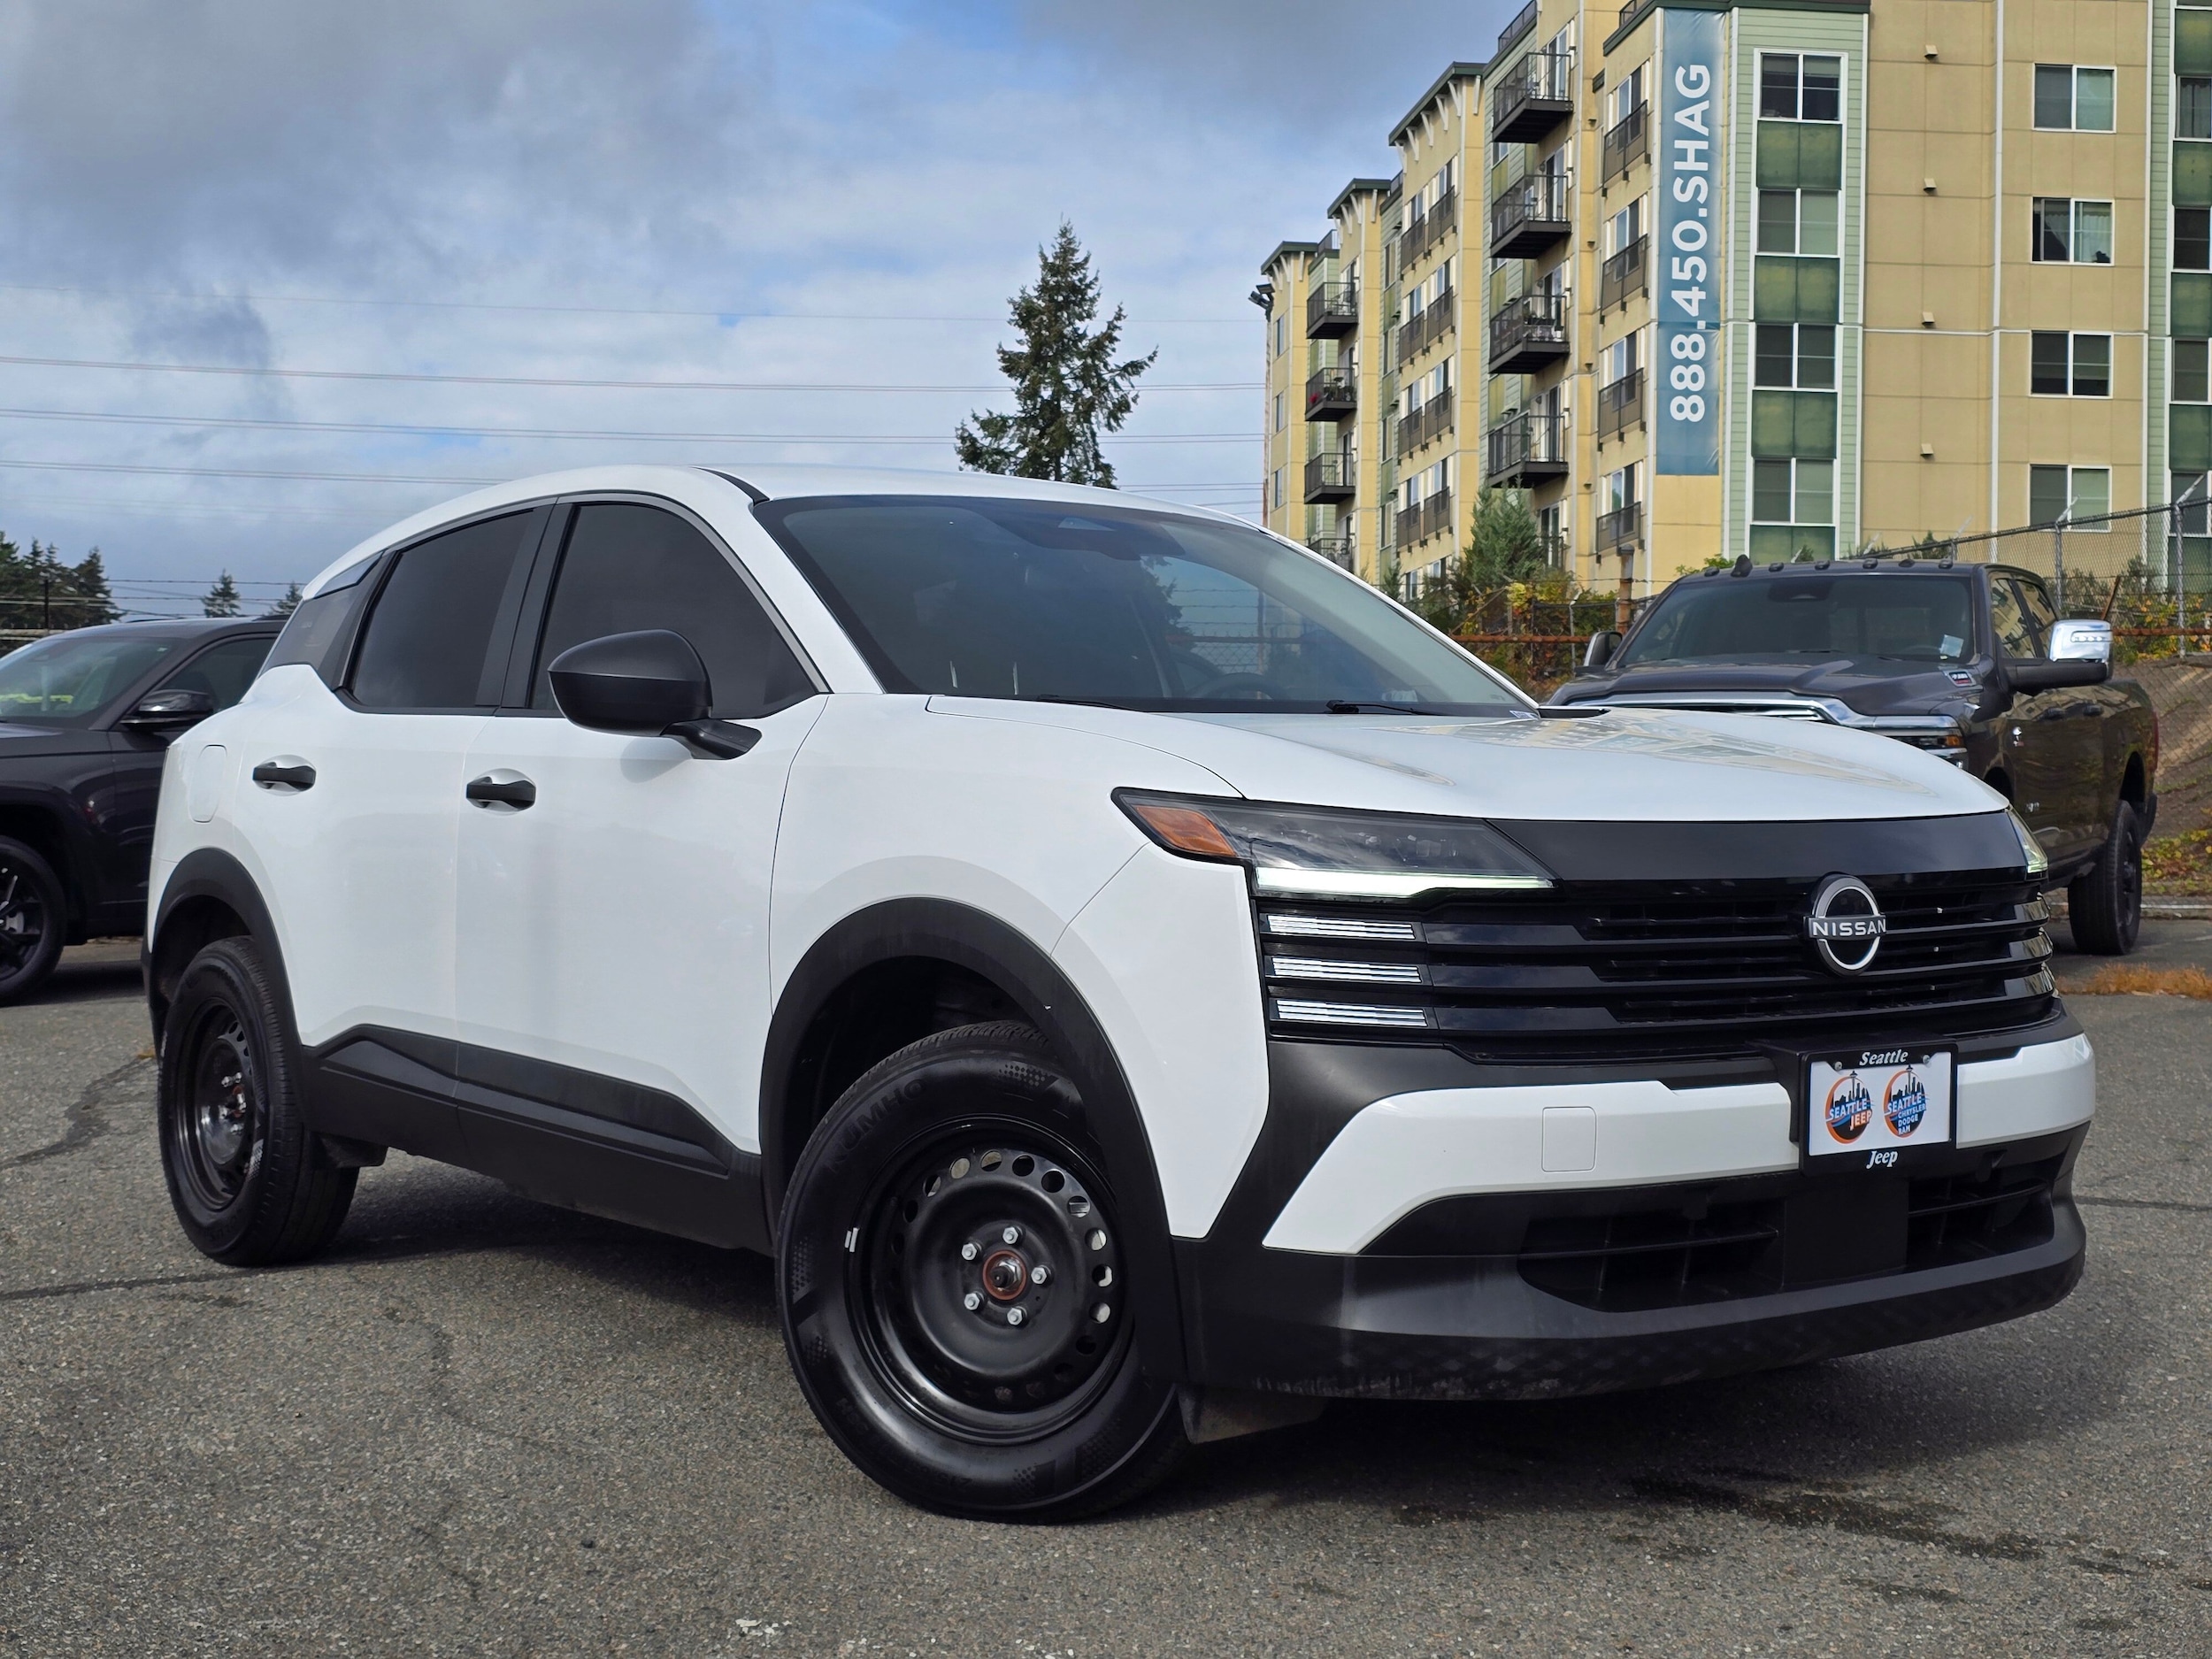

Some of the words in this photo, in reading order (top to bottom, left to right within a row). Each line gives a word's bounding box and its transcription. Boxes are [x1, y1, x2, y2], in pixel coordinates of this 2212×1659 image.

[1670, 64, 1710, 423] 888.450.SHAG
[1812, 918, 1886, 936] NISSAN
[1859, 1048, 1909, 1066] Seattle
[1828, 1097, 1868, 1119] SEATTLE
[1886, 1092, 1923, 1114] SEATTLE
[1898, 1102, 1927, 1119] CHRYSLER
[824, 1079, 926, 1174] KUMHO
[1849, 1109, 1873, 1131] JEEP
[1898, 1113, 1919, 1127] DODGE
[1898, 1125, 1911, 1136] RAM
[1866, 1150, 1898, 1170] Jeep
